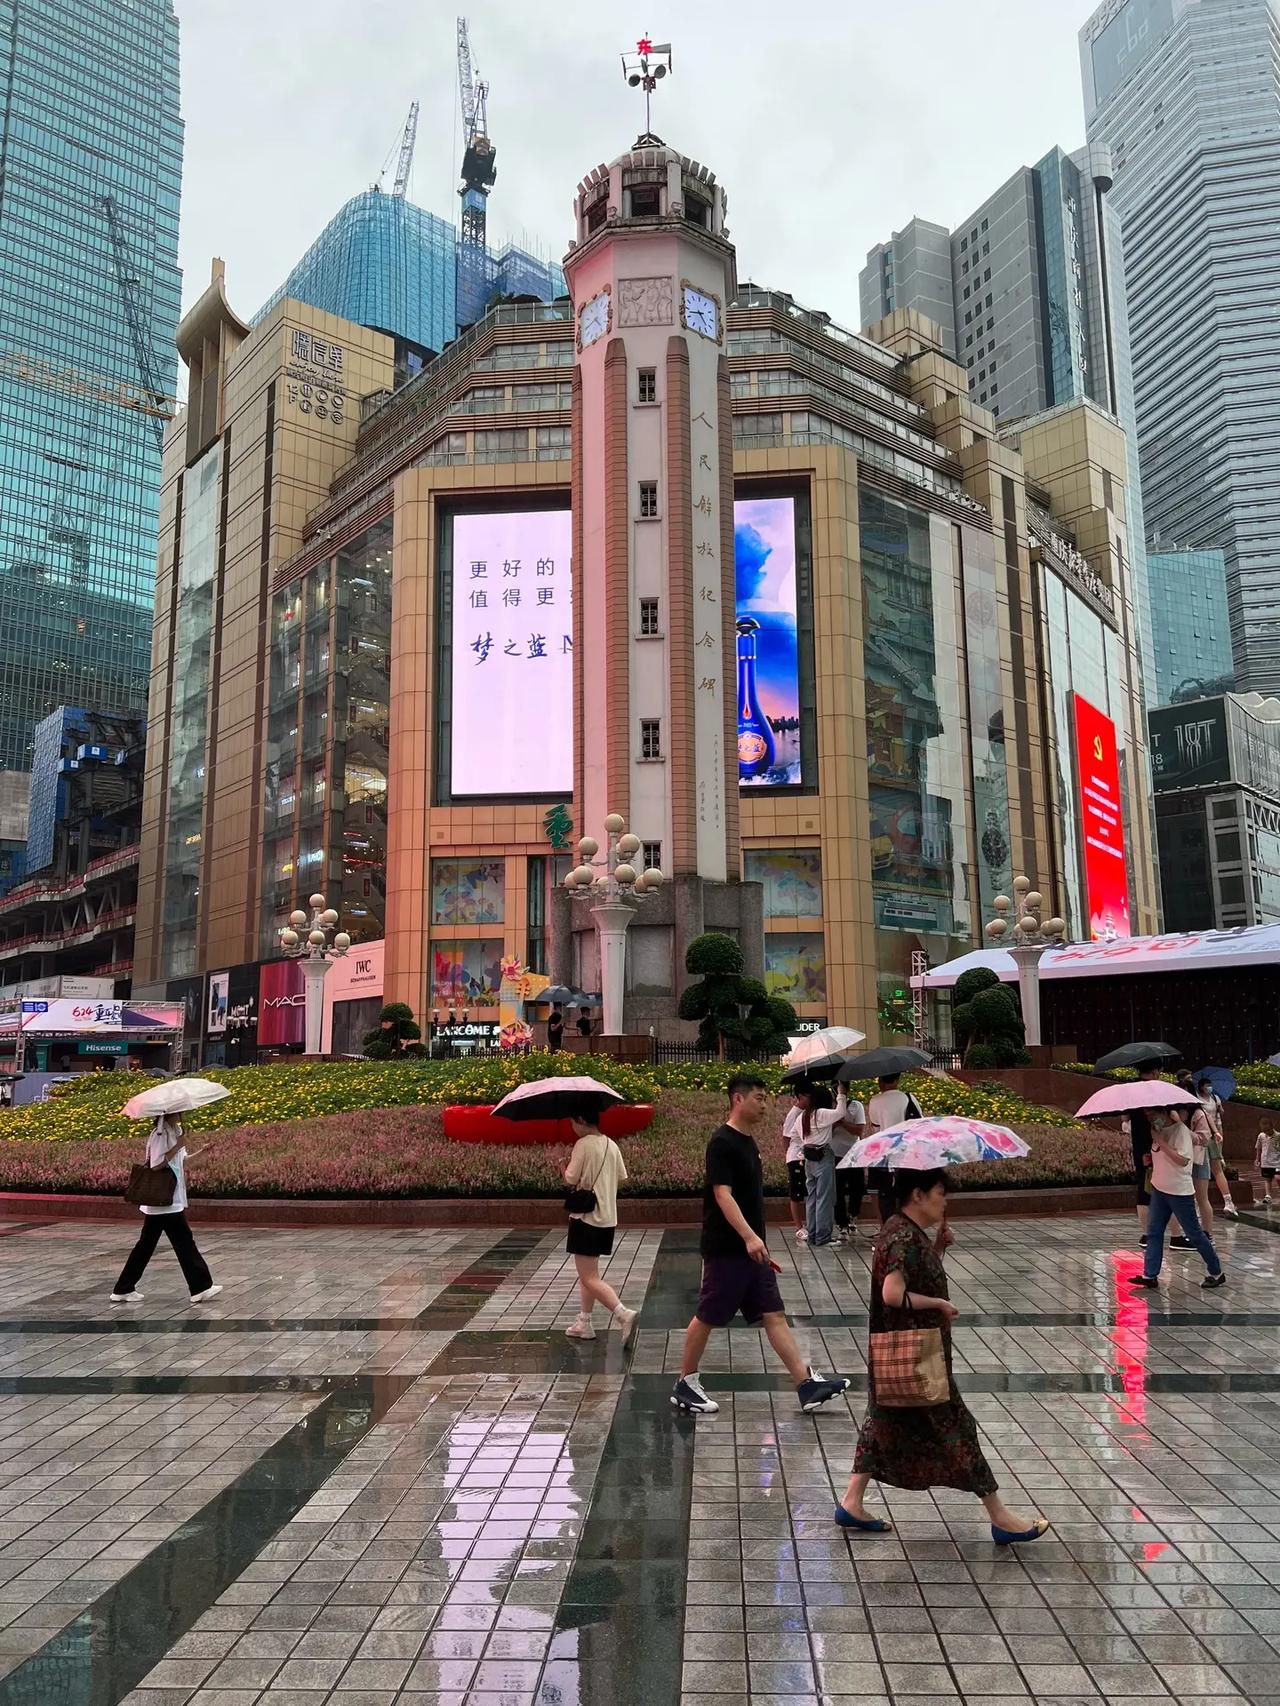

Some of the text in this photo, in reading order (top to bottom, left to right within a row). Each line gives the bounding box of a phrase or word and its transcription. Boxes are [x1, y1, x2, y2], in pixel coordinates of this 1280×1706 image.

[637, 39, 652, 55] 东
[469, 631, 548, 666] 梦之蓝
[355, 959, 372, 975] IWC
[85, 1044, 122, 1052] Hisense
